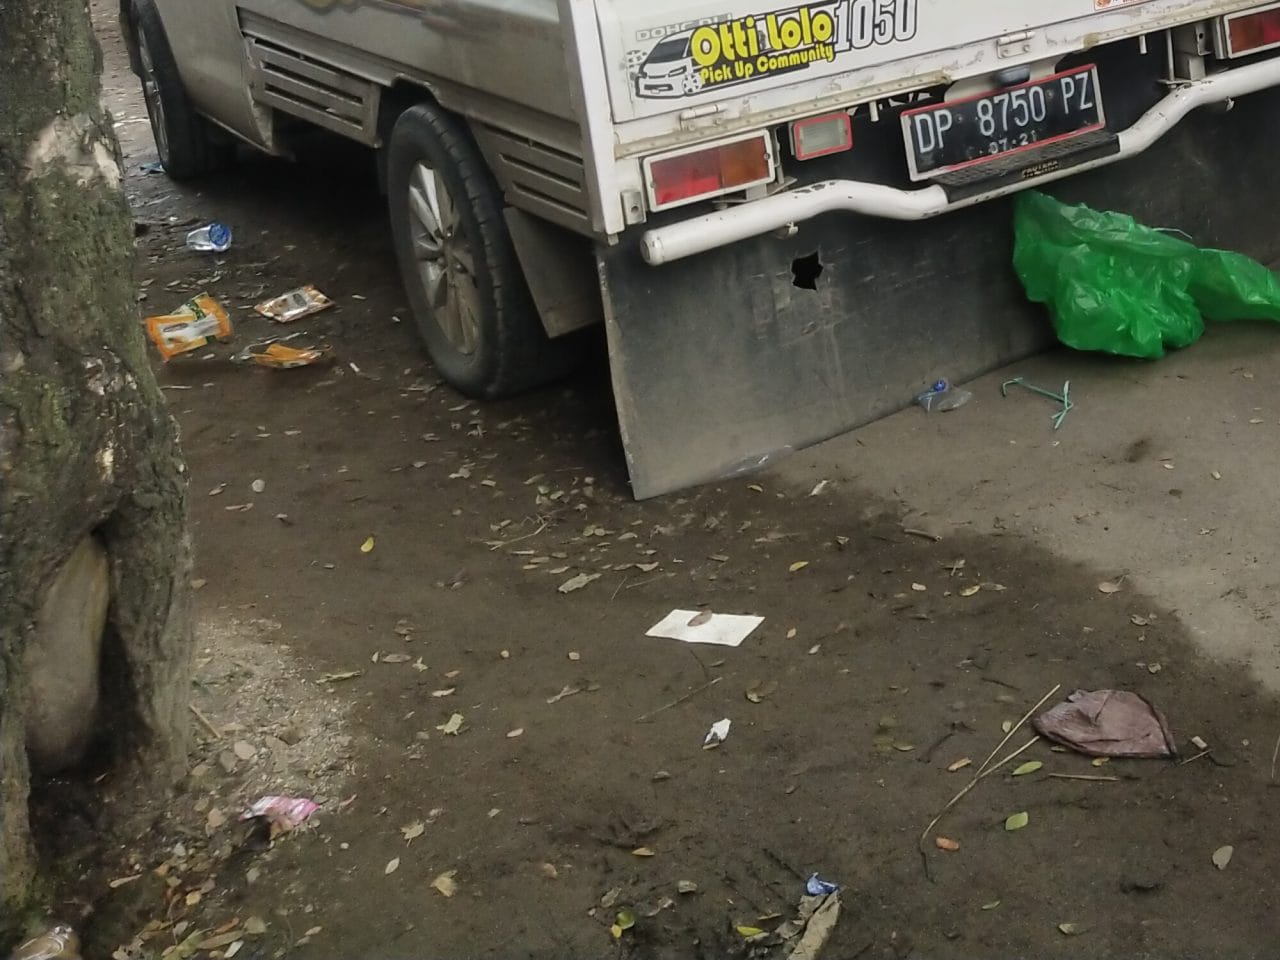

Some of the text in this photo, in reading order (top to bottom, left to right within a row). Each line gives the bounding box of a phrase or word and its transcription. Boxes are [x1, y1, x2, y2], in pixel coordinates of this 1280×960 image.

[700, 43, 835, 85] Pick Up Community
[914, 71, 1094, 154] DP 8750 PZ
